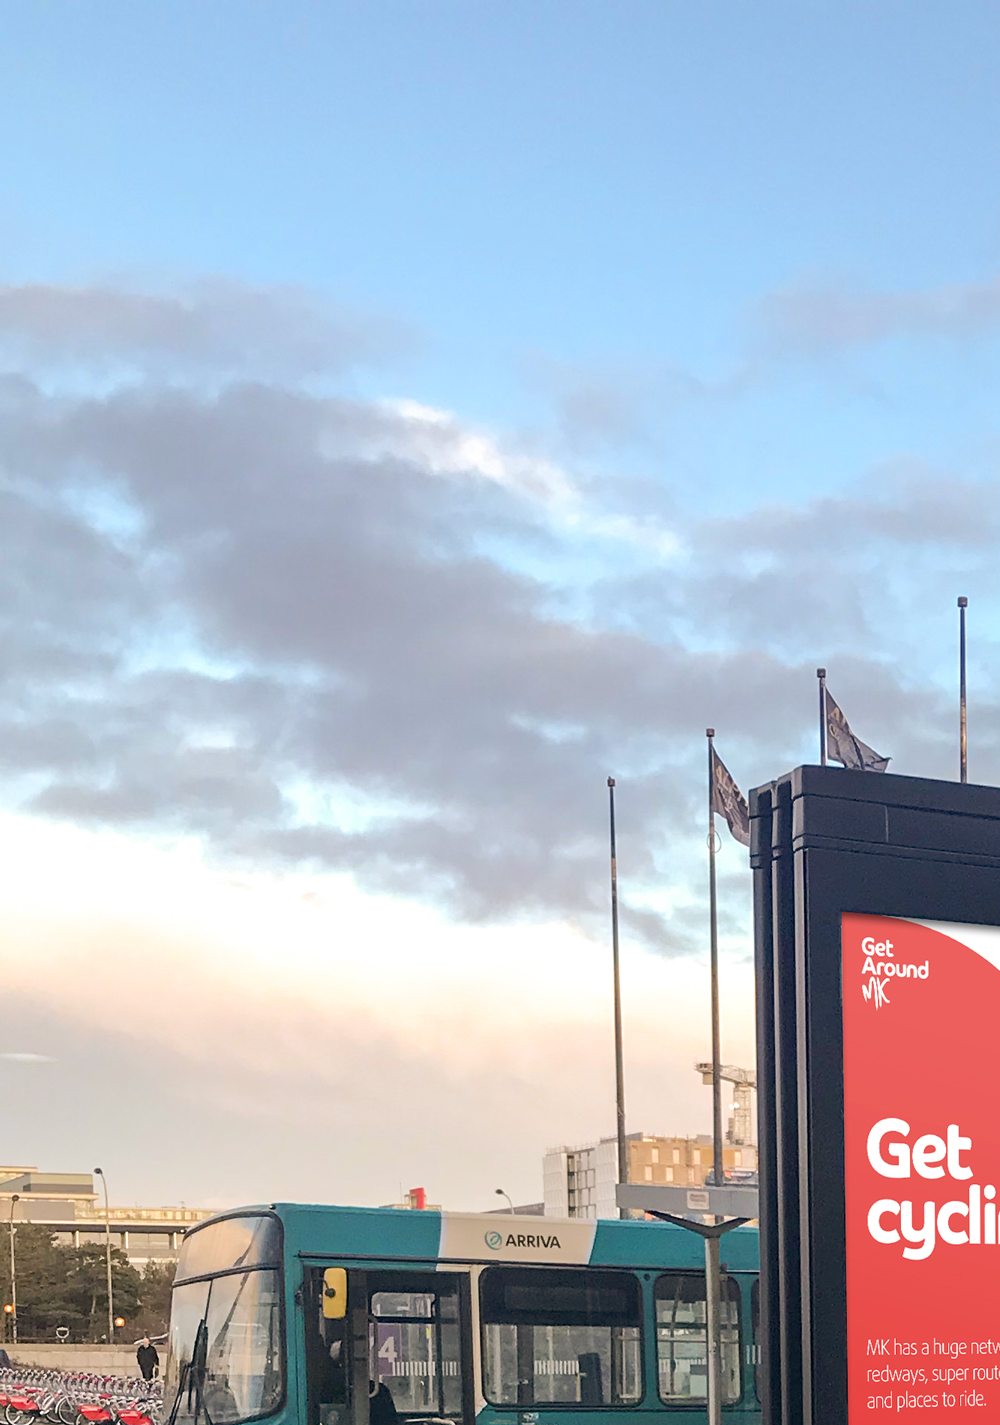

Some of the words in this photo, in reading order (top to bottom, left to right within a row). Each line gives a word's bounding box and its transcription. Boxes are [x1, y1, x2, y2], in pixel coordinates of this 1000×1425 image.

[861, 936, 895, 958] Get
[861, 956, 930, 980] Around
[861, 976, 891, 1011] MK
[866, 1117, 974, 1181] Get
[505, 1234, 561, 1249] ARRIVA
[867, 1339, 890, 1356] MK
[893, 1338, 918, 1356] has
[921, 1342, 930, 1355] a
[933, 1337, 968, 1360] huge
[867, 1364, 929, 1386] redways,
[931, 1367, 970, 1385] super
[867, 1391, 893, 1409] and
[896, 1390, 939, 1412] places
[942, 1391, 956, 1407] to
[959, 1389, 987, 1407] ride.
